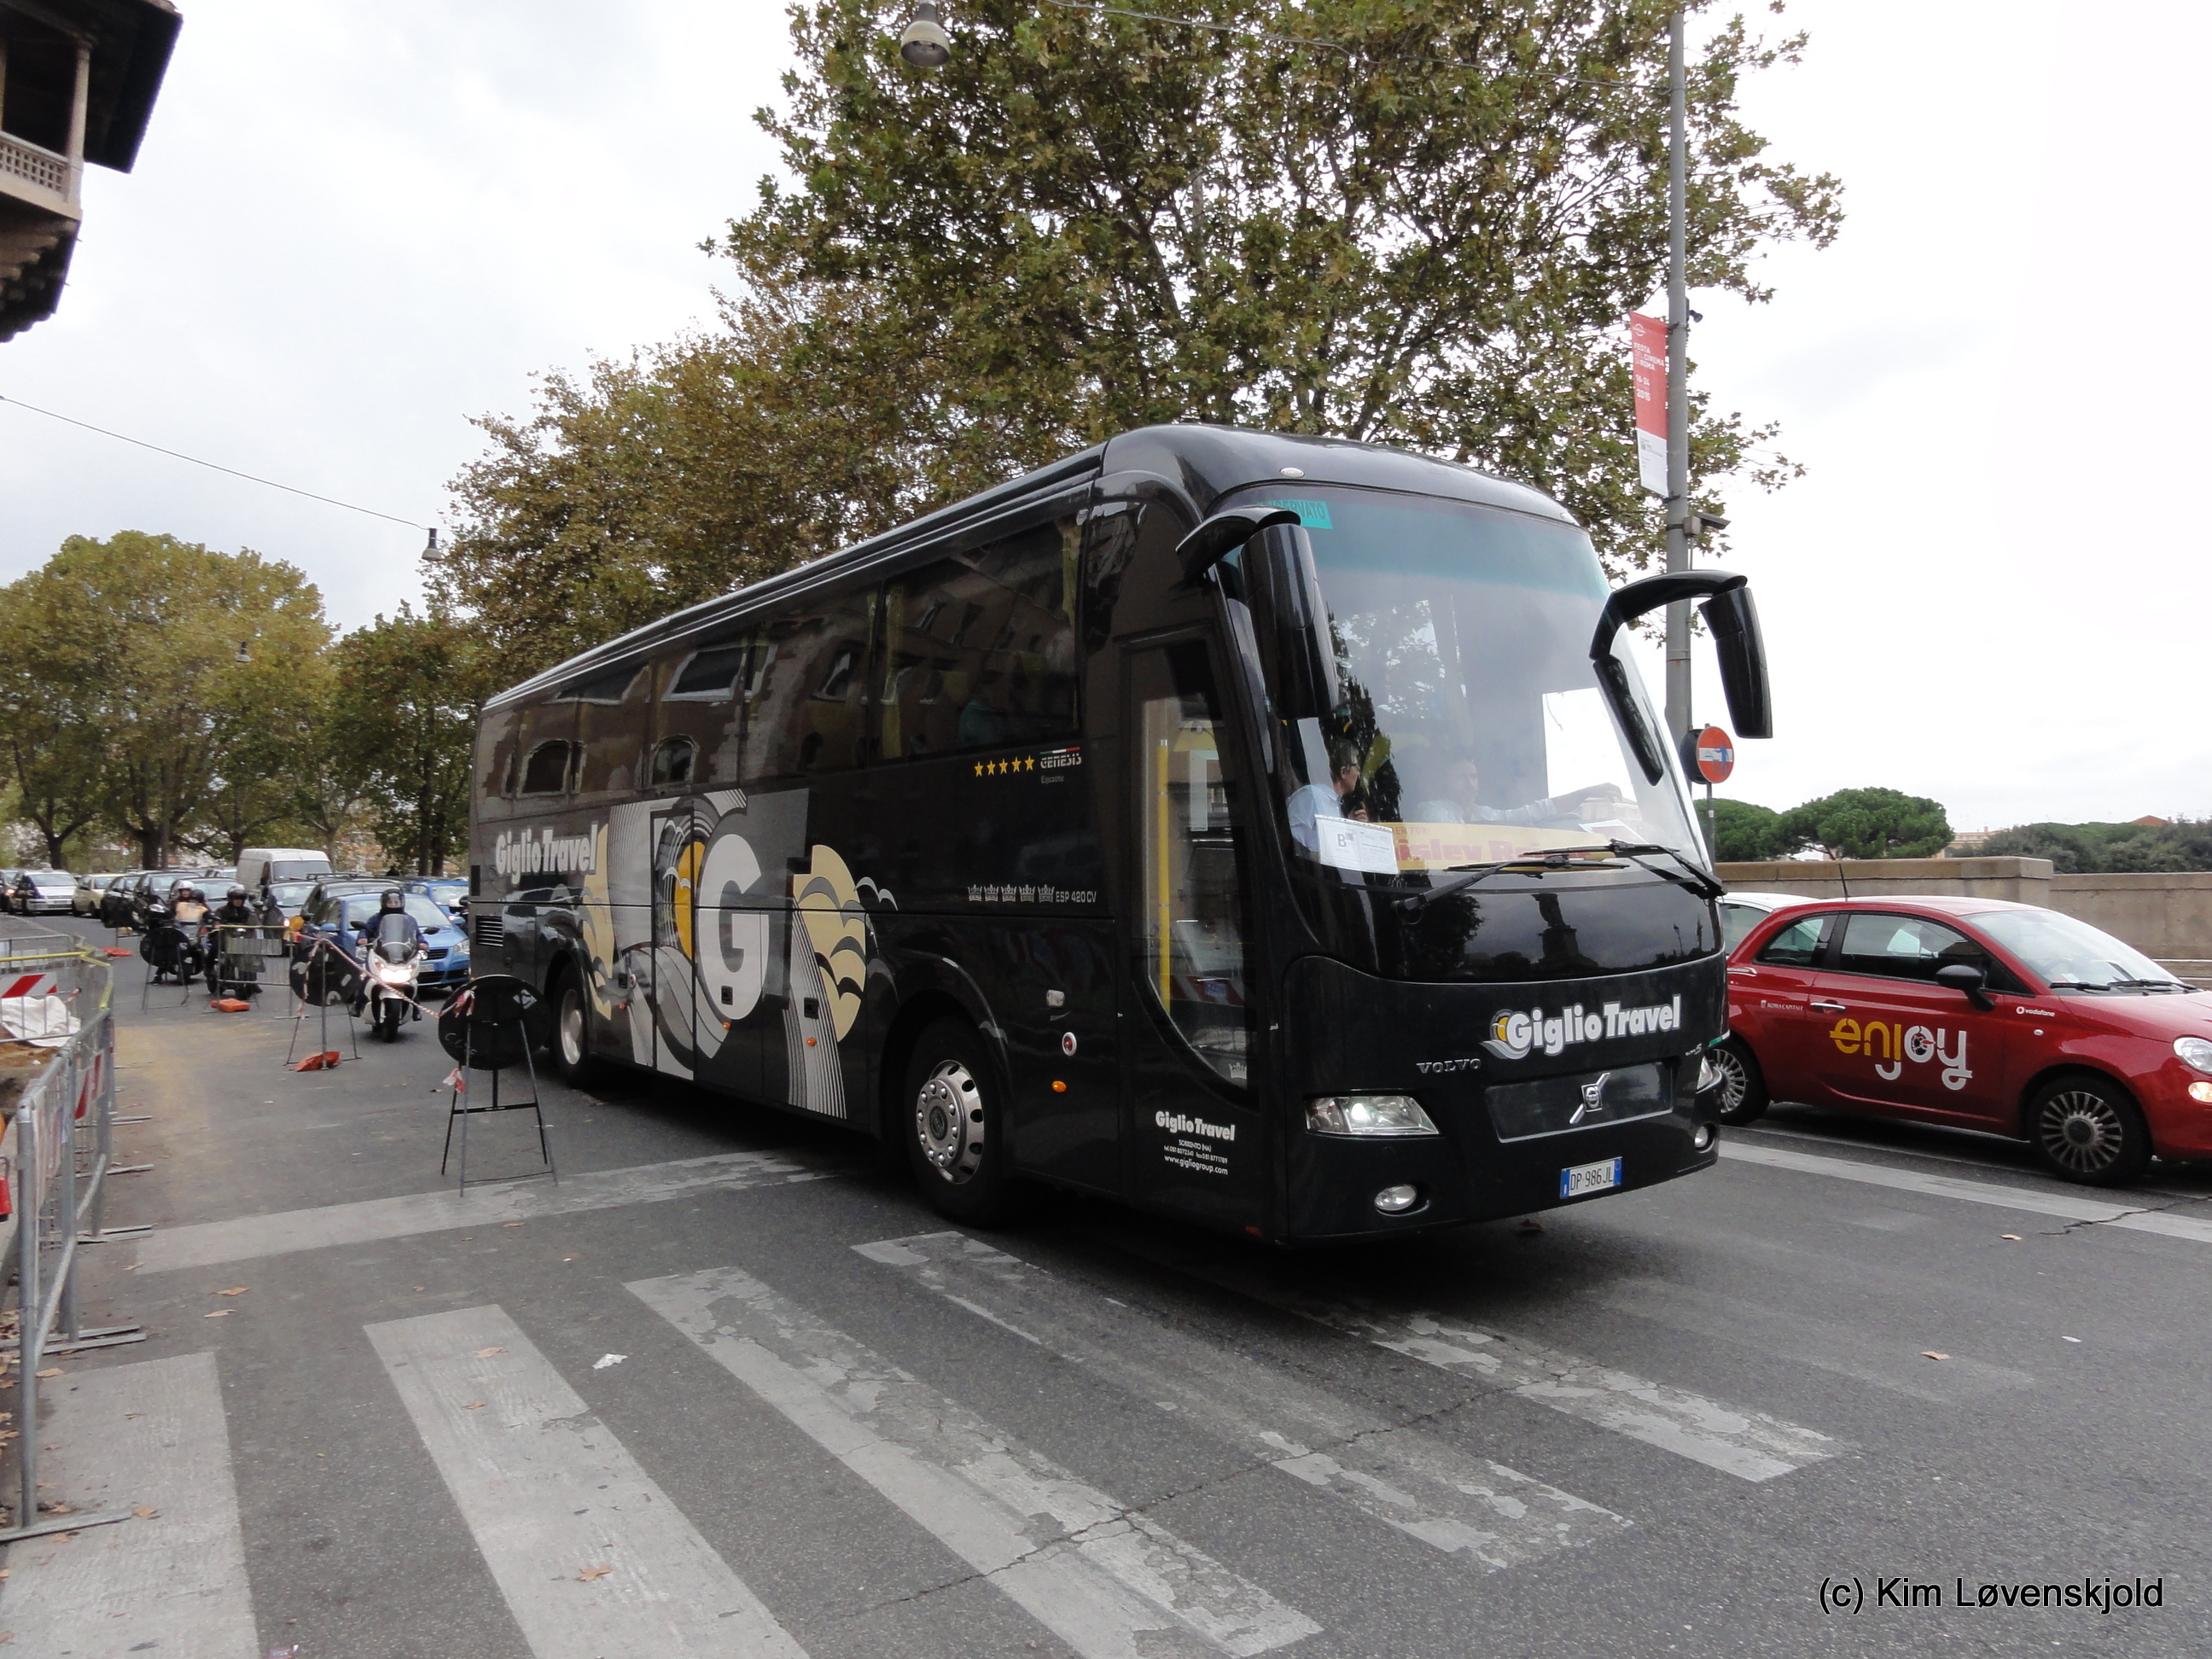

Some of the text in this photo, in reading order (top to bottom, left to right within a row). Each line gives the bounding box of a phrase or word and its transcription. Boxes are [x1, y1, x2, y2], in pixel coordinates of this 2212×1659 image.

[1633, 342, 1650, 354] FESTA
[1040, 753, 1082, 769] GENESIS
[1056, 891, 1070, 903] ESP
[2025, 1009, 2055, 1017] vodafone
[1830, 1018, 1973, 1091] enjoy
[1416, 1058, 1481, 1074] VOLVO
[1164, 1155, 1229, 1175] www.gigliogroup.com
